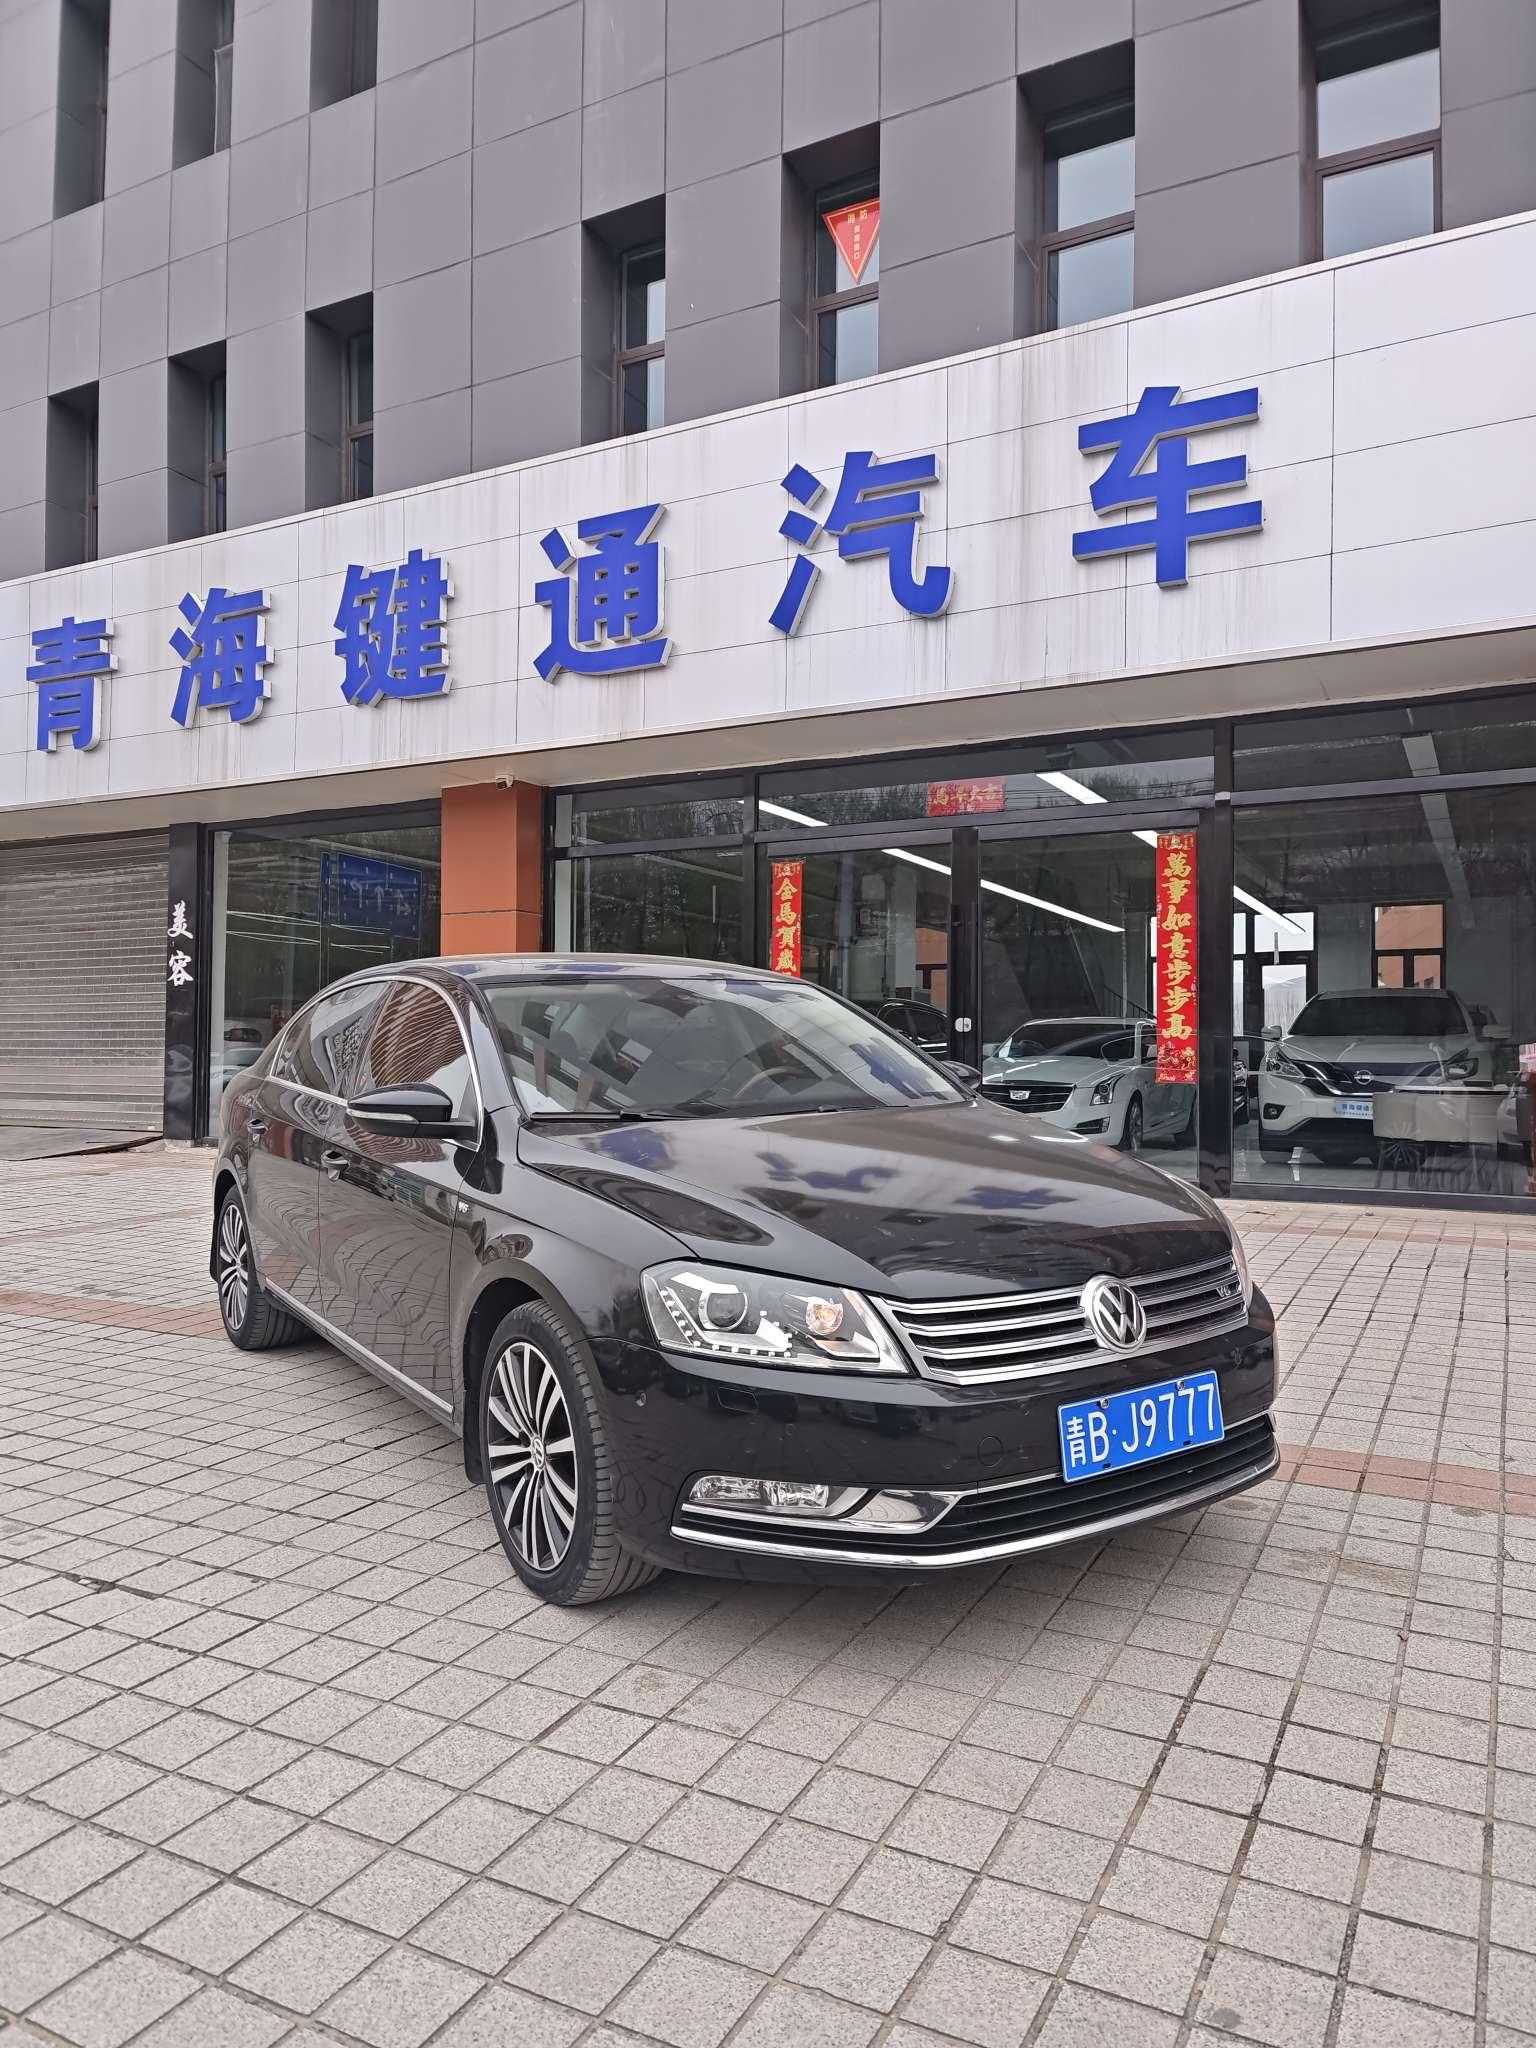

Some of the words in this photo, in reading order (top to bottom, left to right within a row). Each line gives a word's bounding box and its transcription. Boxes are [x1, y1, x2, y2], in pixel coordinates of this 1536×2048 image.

[27, 386, 1263, 752] 青海键通汽车
[167, 899, 194, 987] 美容
[1161, 851, 1192, 1040] 萬事如意步步高
